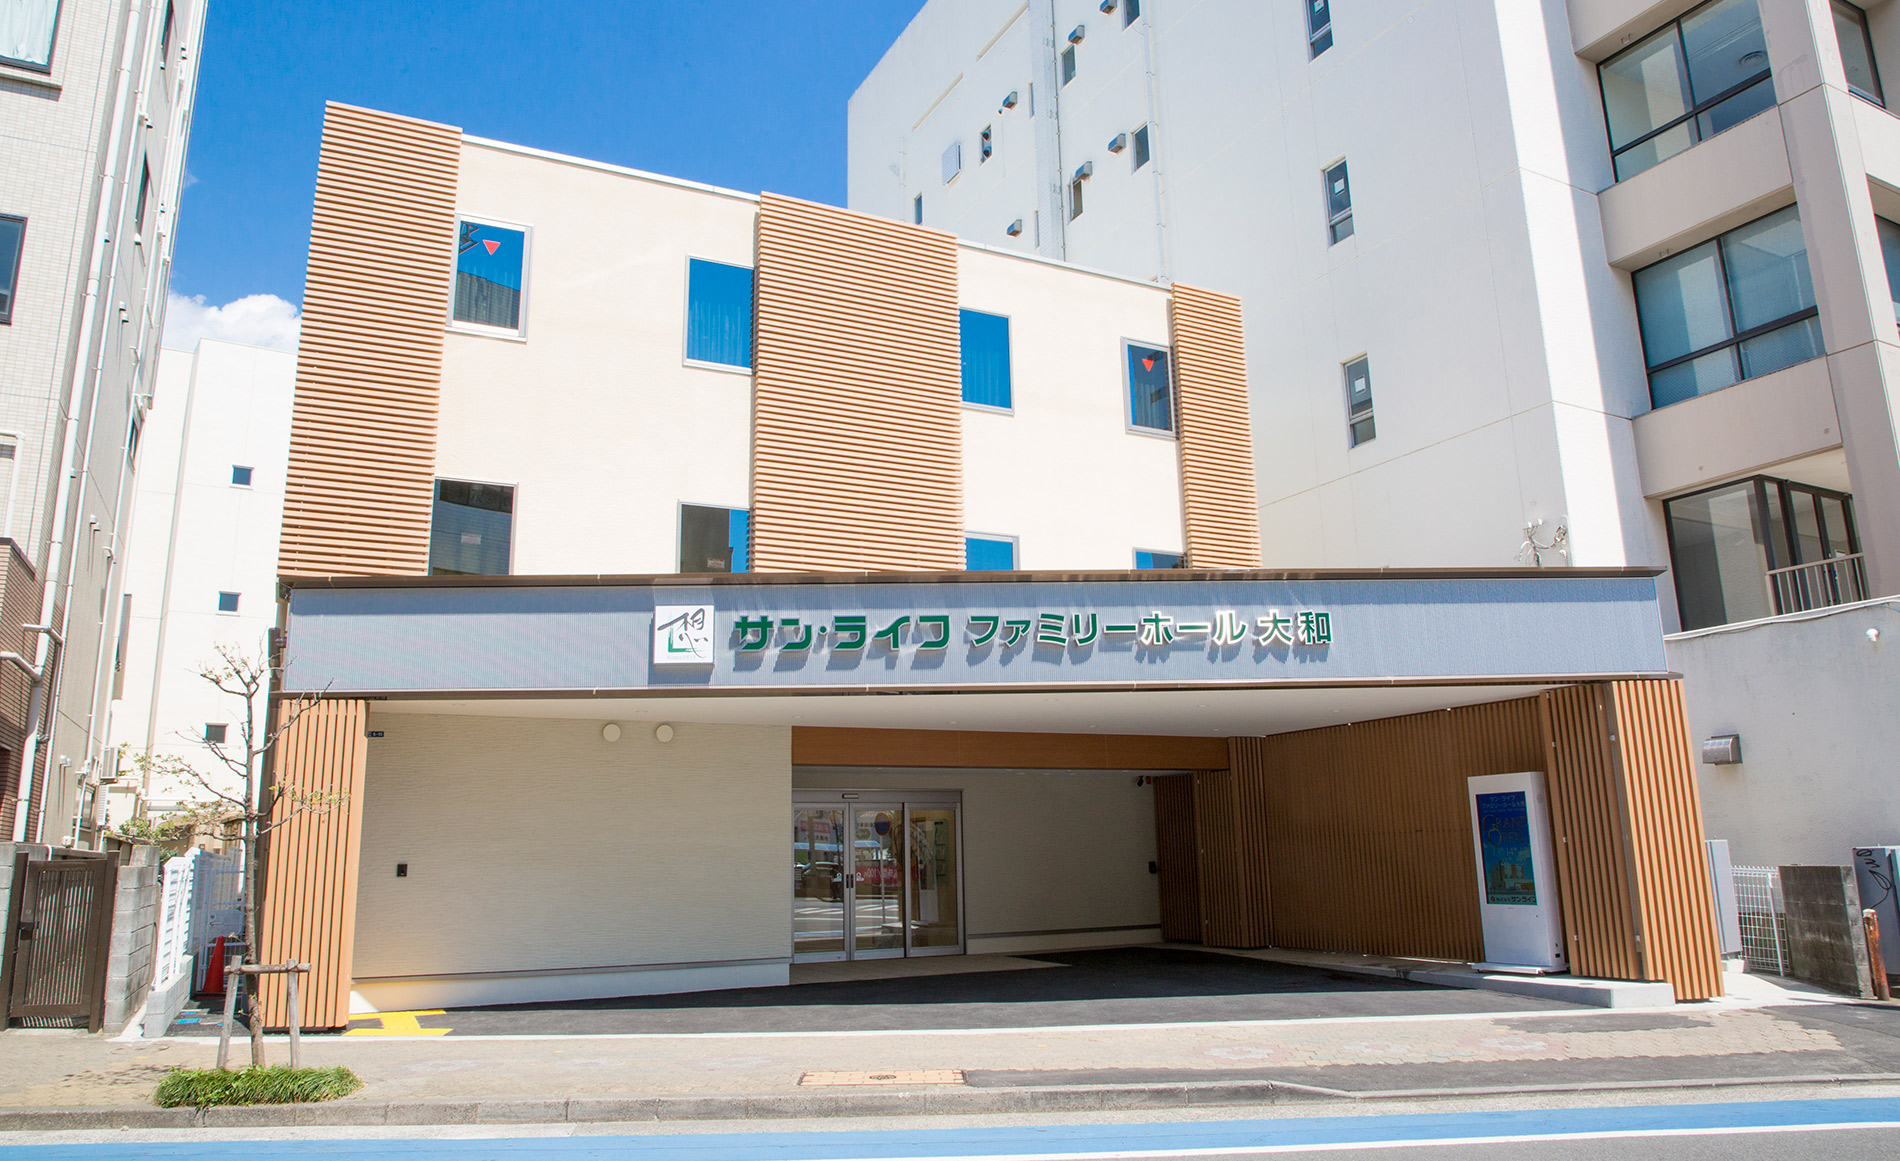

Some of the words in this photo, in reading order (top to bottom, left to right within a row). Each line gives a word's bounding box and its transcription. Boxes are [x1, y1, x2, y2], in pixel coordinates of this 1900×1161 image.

[733, 614, 950, 651] サン・ライフ
[967, 609, 1248, 647] ファミリーホール
[1257, 608, 1333, 646] 大和
